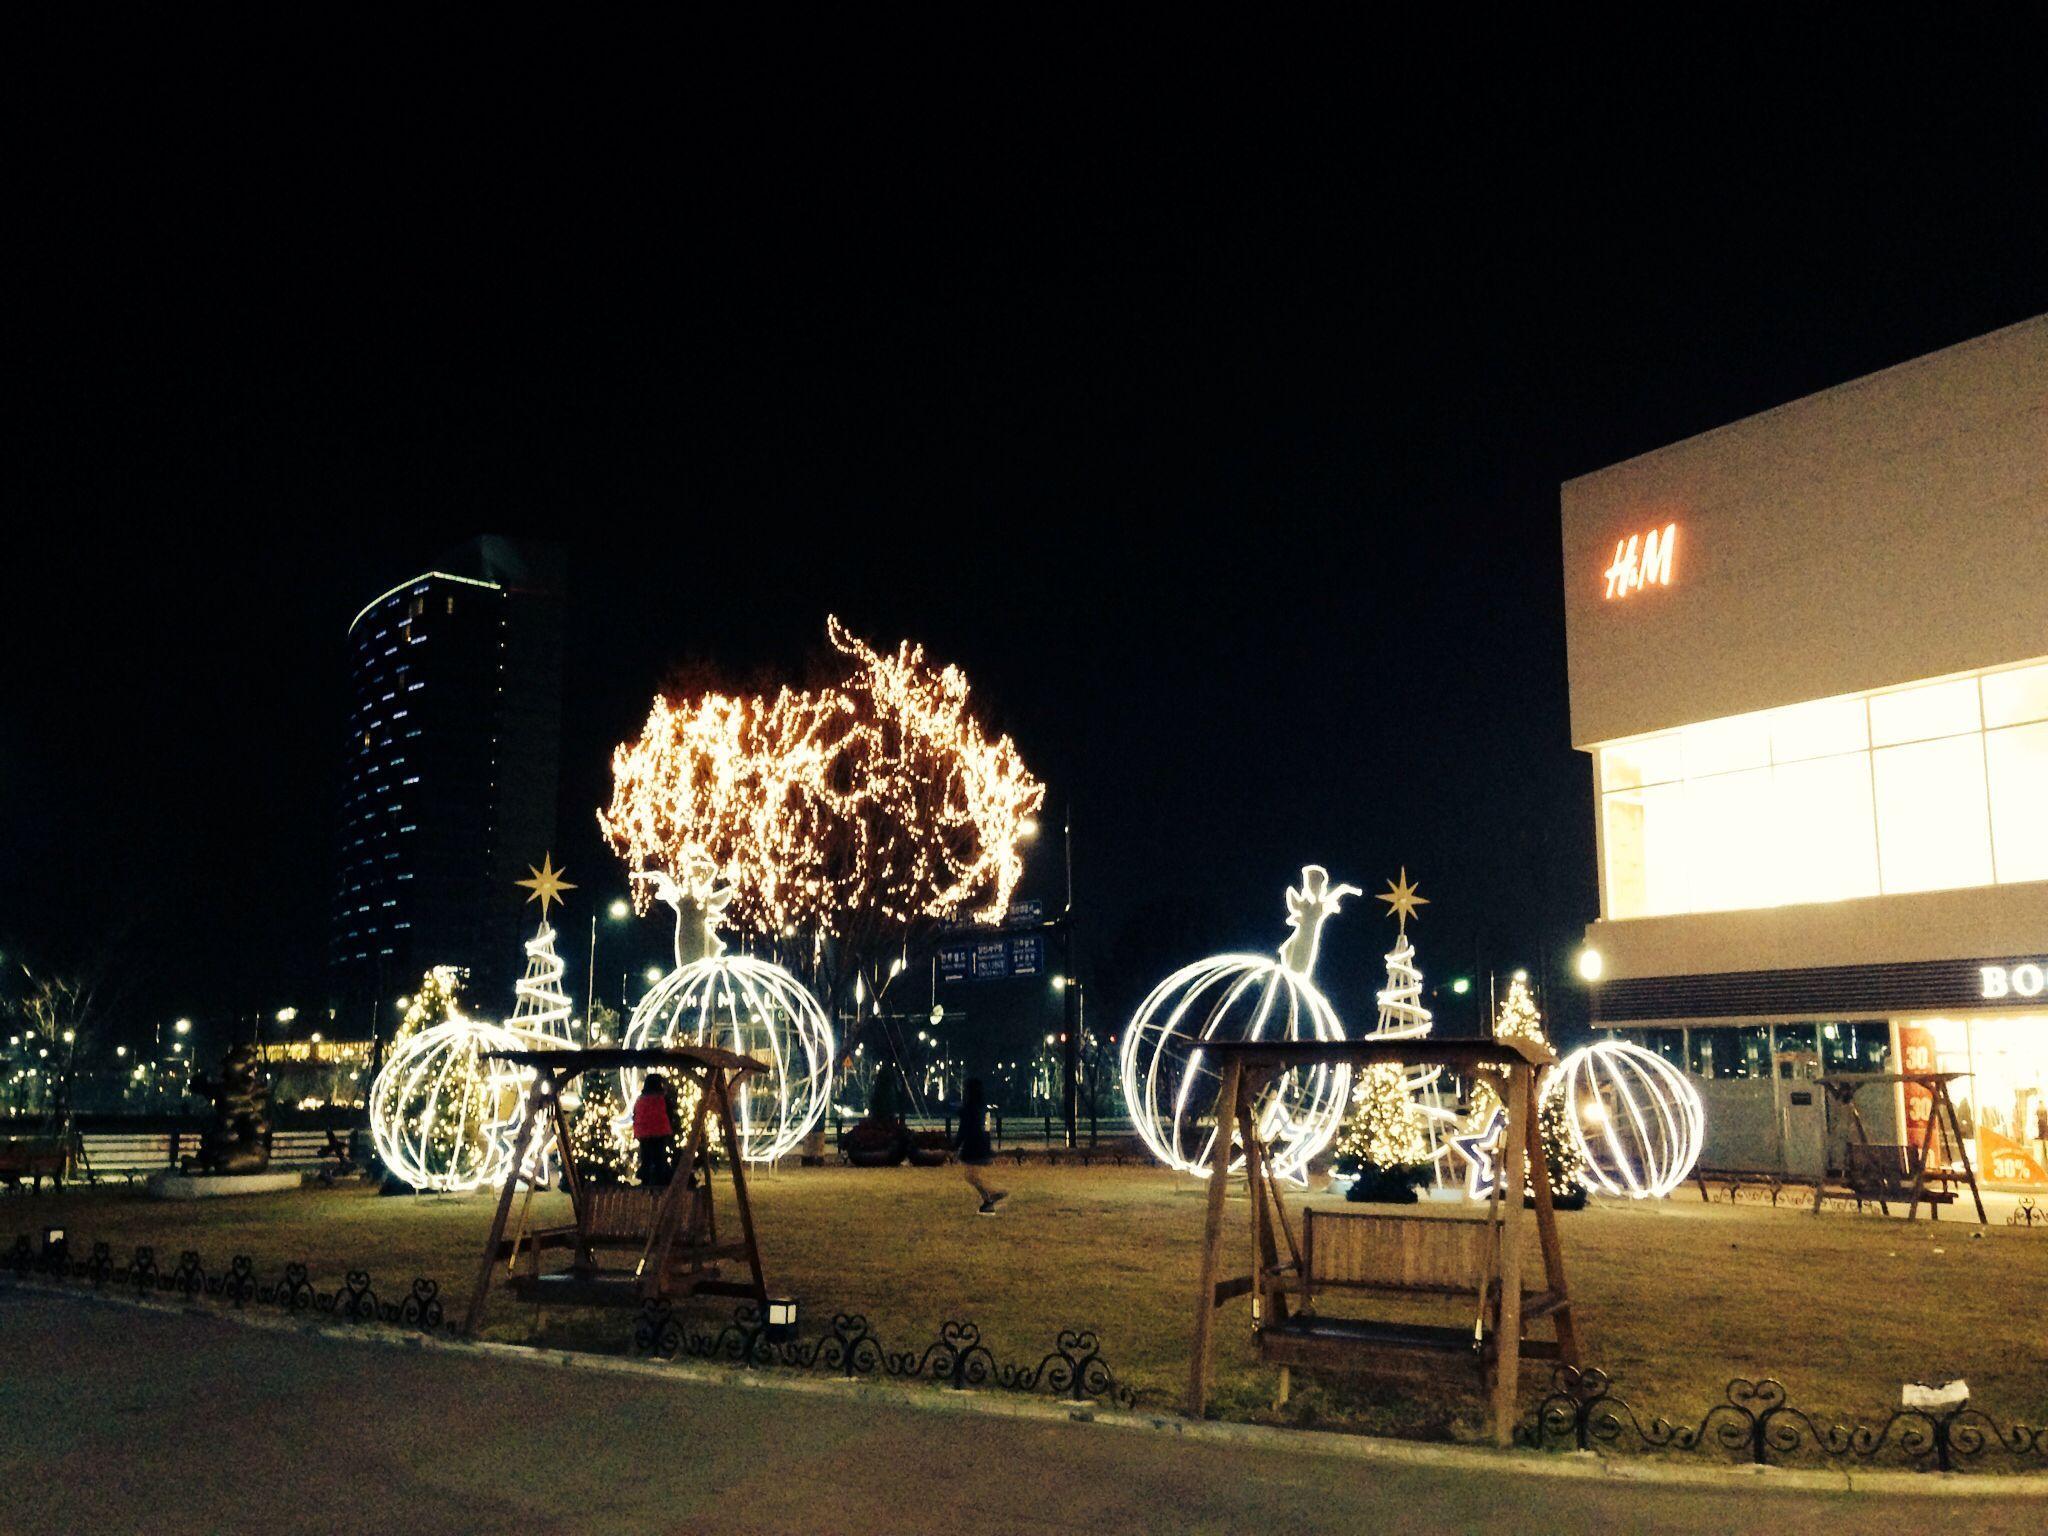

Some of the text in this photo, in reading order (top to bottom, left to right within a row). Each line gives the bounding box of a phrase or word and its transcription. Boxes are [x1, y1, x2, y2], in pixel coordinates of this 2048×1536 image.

[1604, 523, 1676, 599] H&M
[1906, 1046, 1928, 1070] 30
[1909, 1096, 1932, 1121] 30
[1993, 1158, 2030, 1179] 30%
